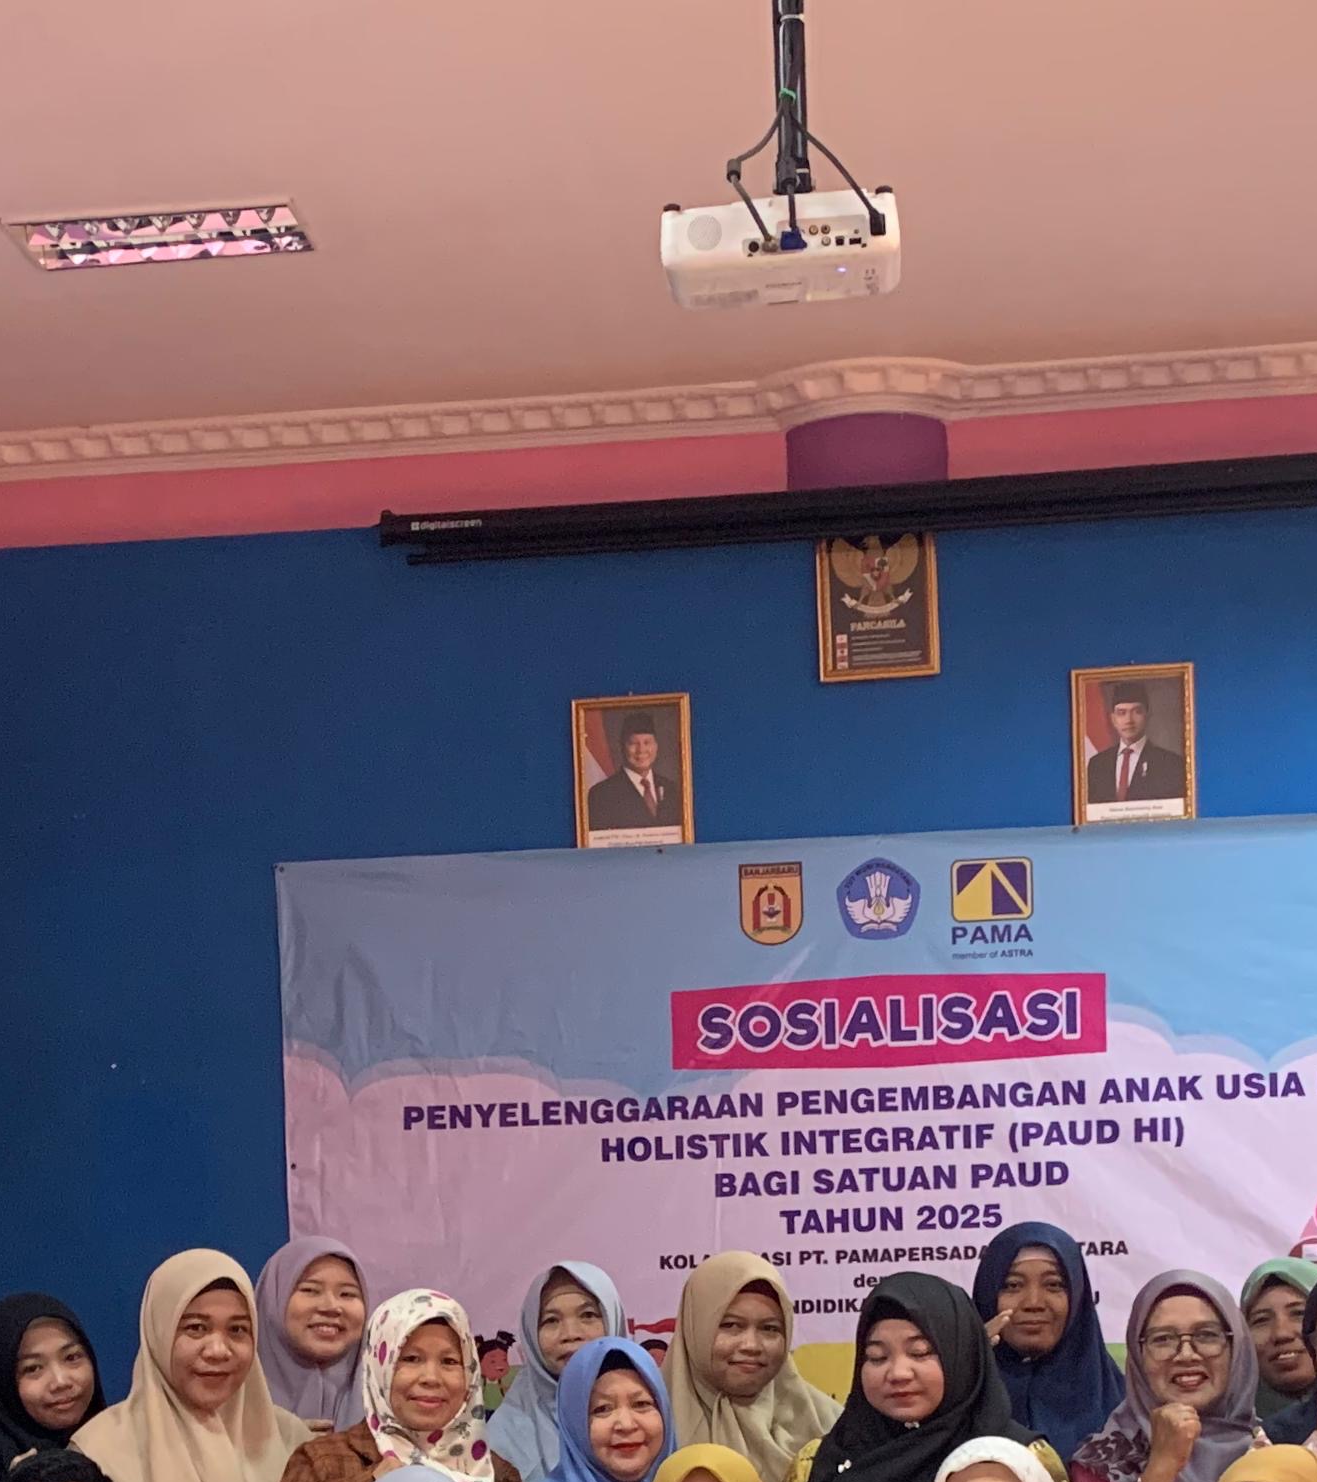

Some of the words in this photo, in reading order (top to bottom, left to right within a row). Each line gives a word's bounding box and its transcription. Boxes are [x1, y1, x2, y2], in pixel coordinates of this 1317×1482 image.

[951, 923, 1034, 945] PAMA
[952, 951, 987, 960] member
[989, 950, 999, 959] of
[1000, 949, 1034, 958] ASTRA
[697, 987, 1081, 1055] SOSIALISASI
[403, 1092, 763, 1131] PENYELENGGARAAN
[776, 1079, 1086, 1117] PENGEMBANGAN
[1099, 1075, 1203, 1105] ANAK
[1216, 1071, 1306, 1100] USIA
[601, 1132, 770, 1163] HOLISTIK
[780, 1123, 995, 1157] INTEGRATIF
[1008, 1119, 1120, 1153] (PAUD
[1133, 1116, 1185, 1148] HI)
[714, 1170, 800, 1198] BAGI
[813, 1164, 957, 1195] SATUAN
[970, 1160, 1069, 1189] PAUD
[779, 1206, 904, 1235] TAHUN
[916, 1203, 1003, 1231] 2025
[799, 1250, 828, 1266] PT.
